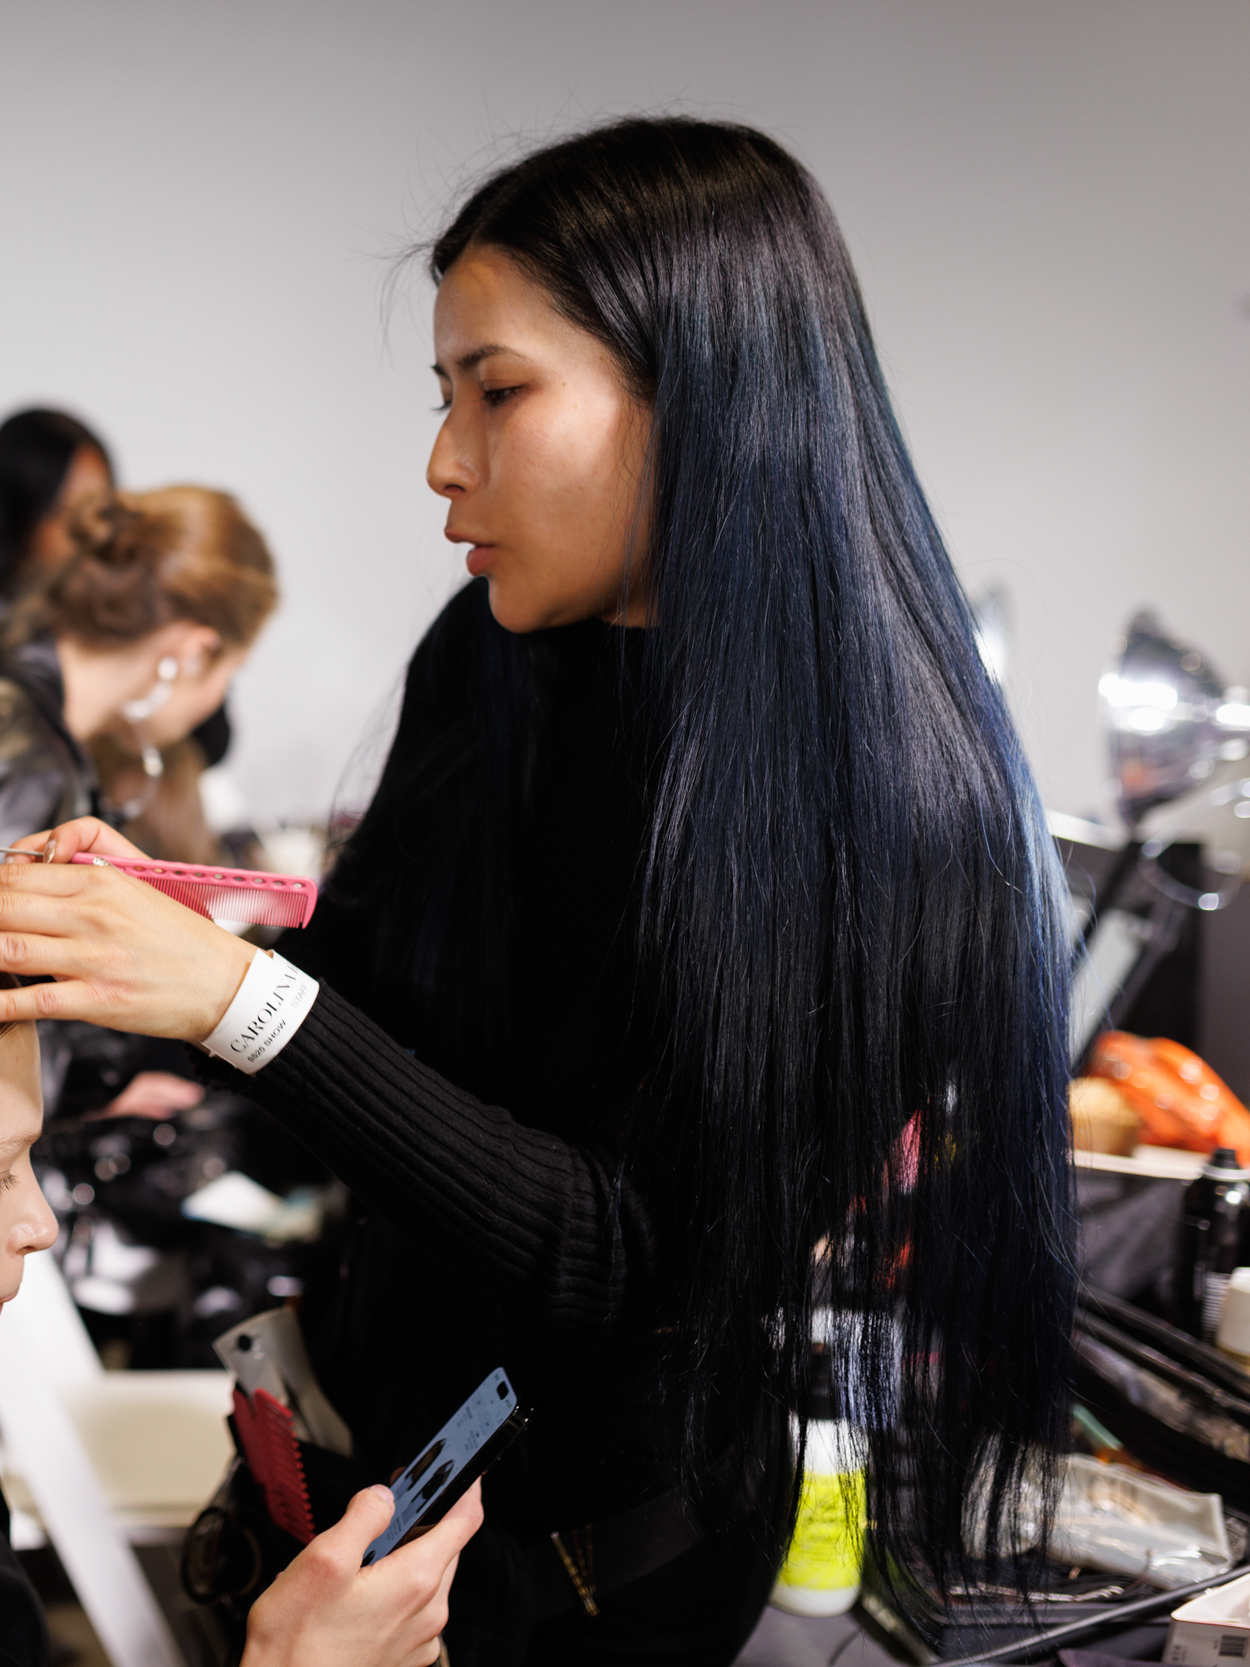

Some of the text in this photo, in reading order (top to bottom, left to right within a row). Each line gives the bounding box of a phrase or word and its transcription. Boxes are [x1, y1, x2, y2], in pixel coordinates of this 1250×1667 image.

[230, 973, 296, 1053] CAROLINA
[263, 1019, 287, 1047] SHOW
[291, 984, 309, 1010] STAFF
